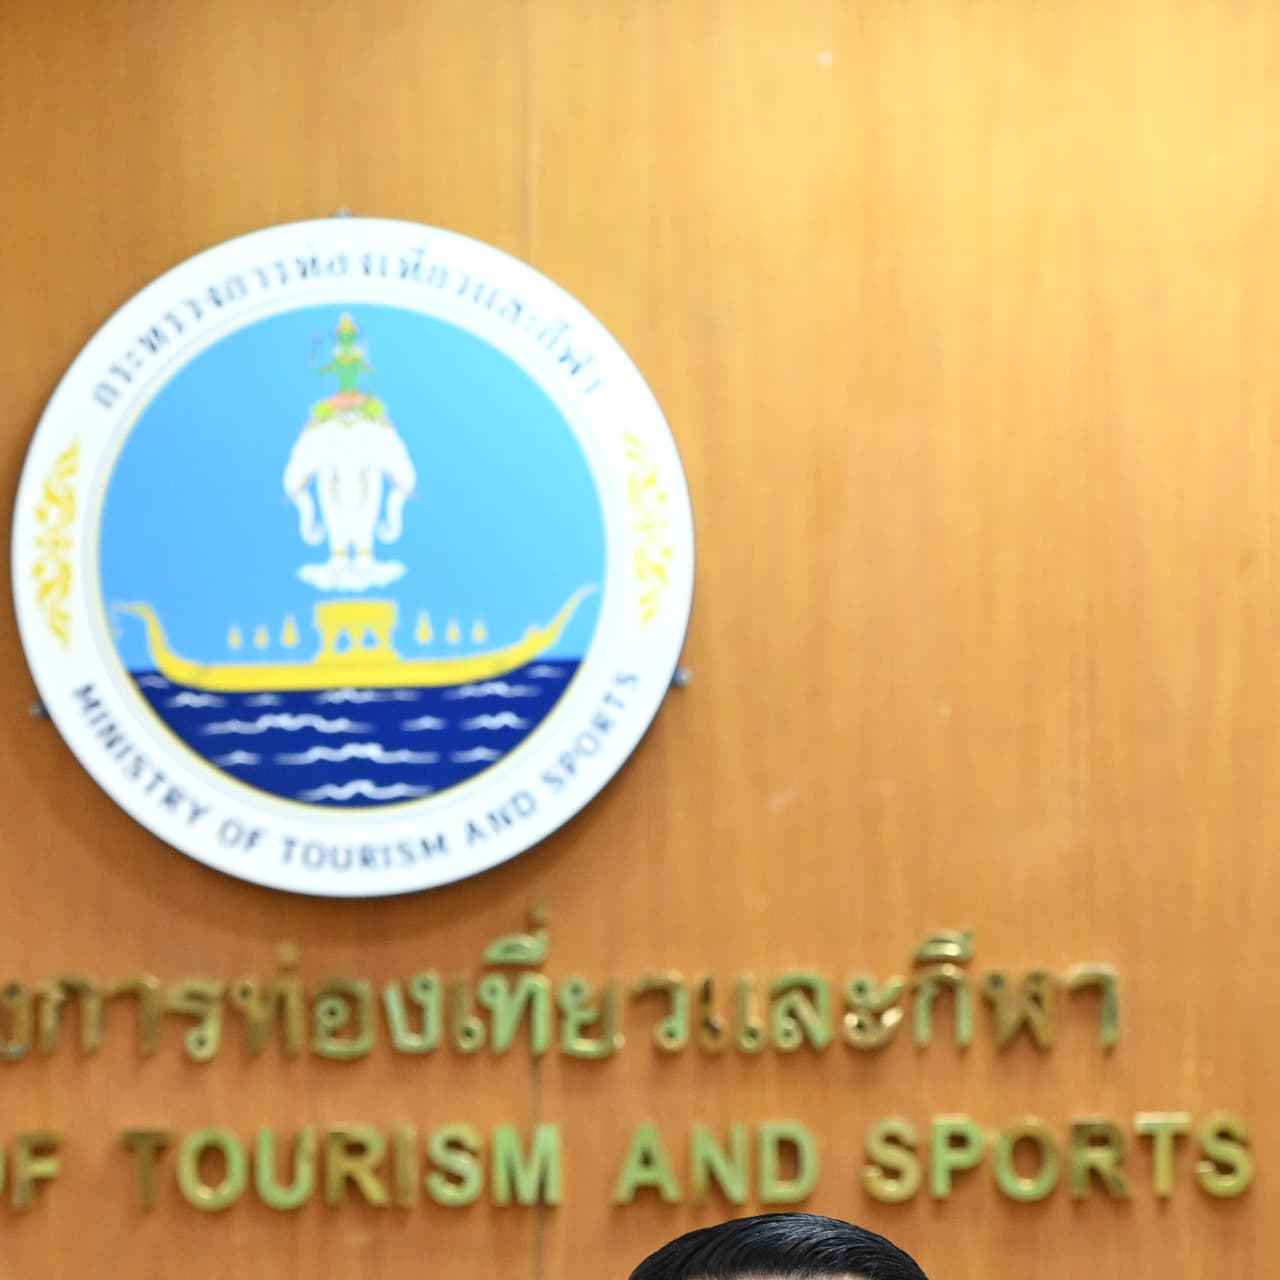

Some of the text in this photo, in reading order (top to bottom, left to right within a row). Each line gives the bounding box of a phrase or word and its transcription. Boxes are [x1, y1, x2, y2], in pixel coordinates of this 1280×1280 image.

[73, 671, 640, 871] MINISTRY OF TOURISM AND SPORTS
[118, 1120, 564, 1214] TOURISM
[615, 1119, 822, 1206] AND
[863, 1109, 1256, 1206] SPORTS
